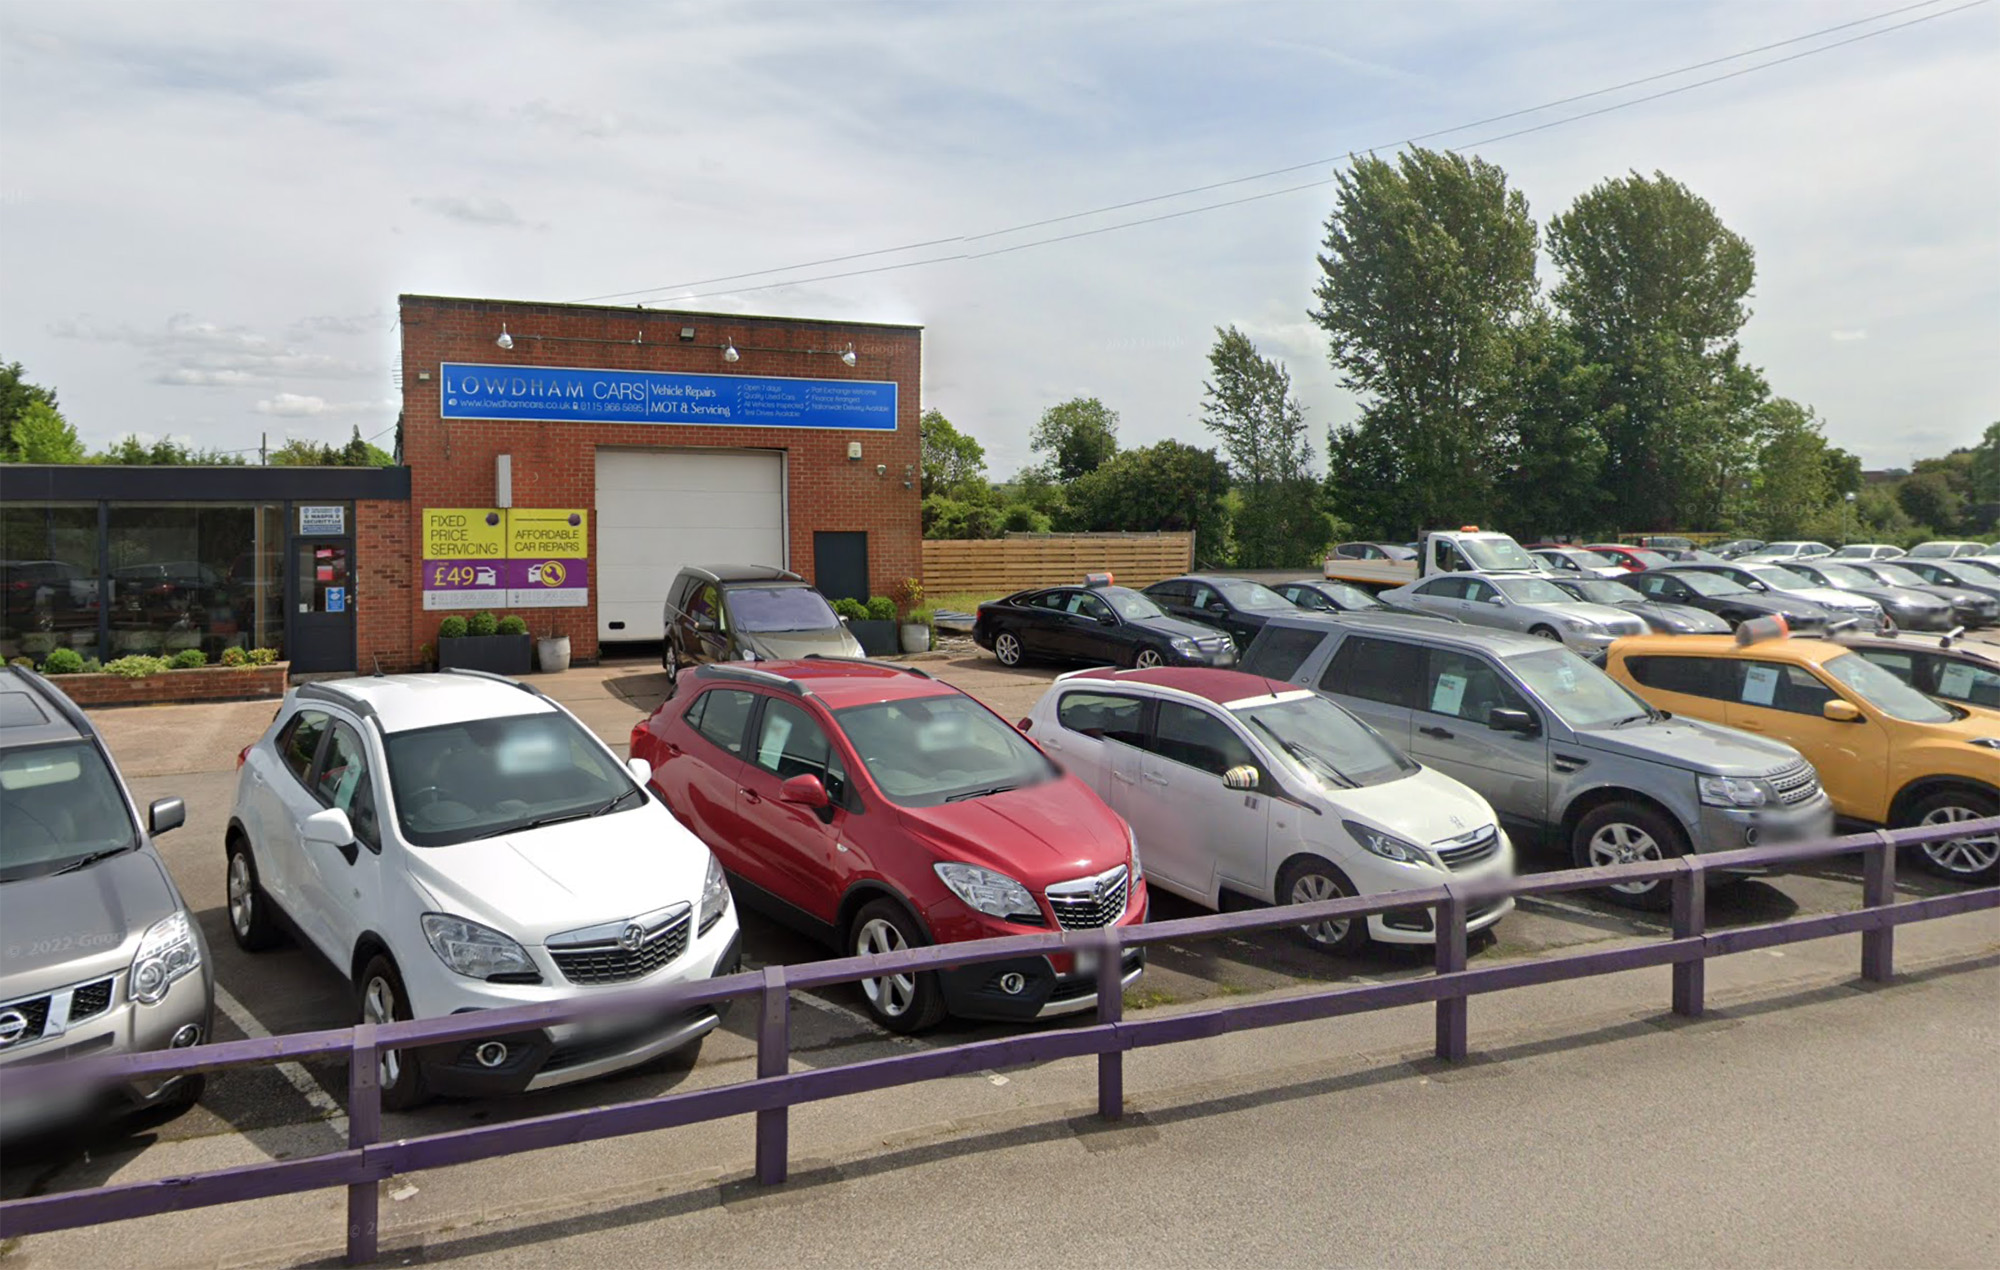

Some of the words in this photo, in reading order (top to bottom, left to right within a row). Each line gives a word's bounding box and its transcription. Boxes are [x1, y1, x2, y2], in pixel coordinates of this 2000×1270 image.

[447, 376, 584, 398] LOWDHAM
[593, 381, 645, 401] CARS
[651, 384, 683, 397] Vehicle
[685, 385, 717, 400] Repairs
[744, 384, 760, 392] Open
[766, 385, 782, 393] days
[744, 392, 764, 401] Quality
[765, 392, 781, 400] Used
[781, 393, 796, 401] Cars
[460, 399, 571, 411] www.lowdhamcars.co.uk
[580, 401, 603, 412] 0115
[603, 402, 620, 413] 966
[650, 401, 677, 414] MOT
[680, 402, 689, 414] &
[691, 402, 731, 418] Servicing
[430, 515, 466, 527] FIXED
[430, 529, 468, 541] PRICE
[515, 529, 579, 540] AFFORDABLE
[430, 543, 499, 556] SERVICING
[514, 541, 536, 552] CAR
[538, 541, 580, 552] REPAIRS
[433, 566, 475, 586] £49
